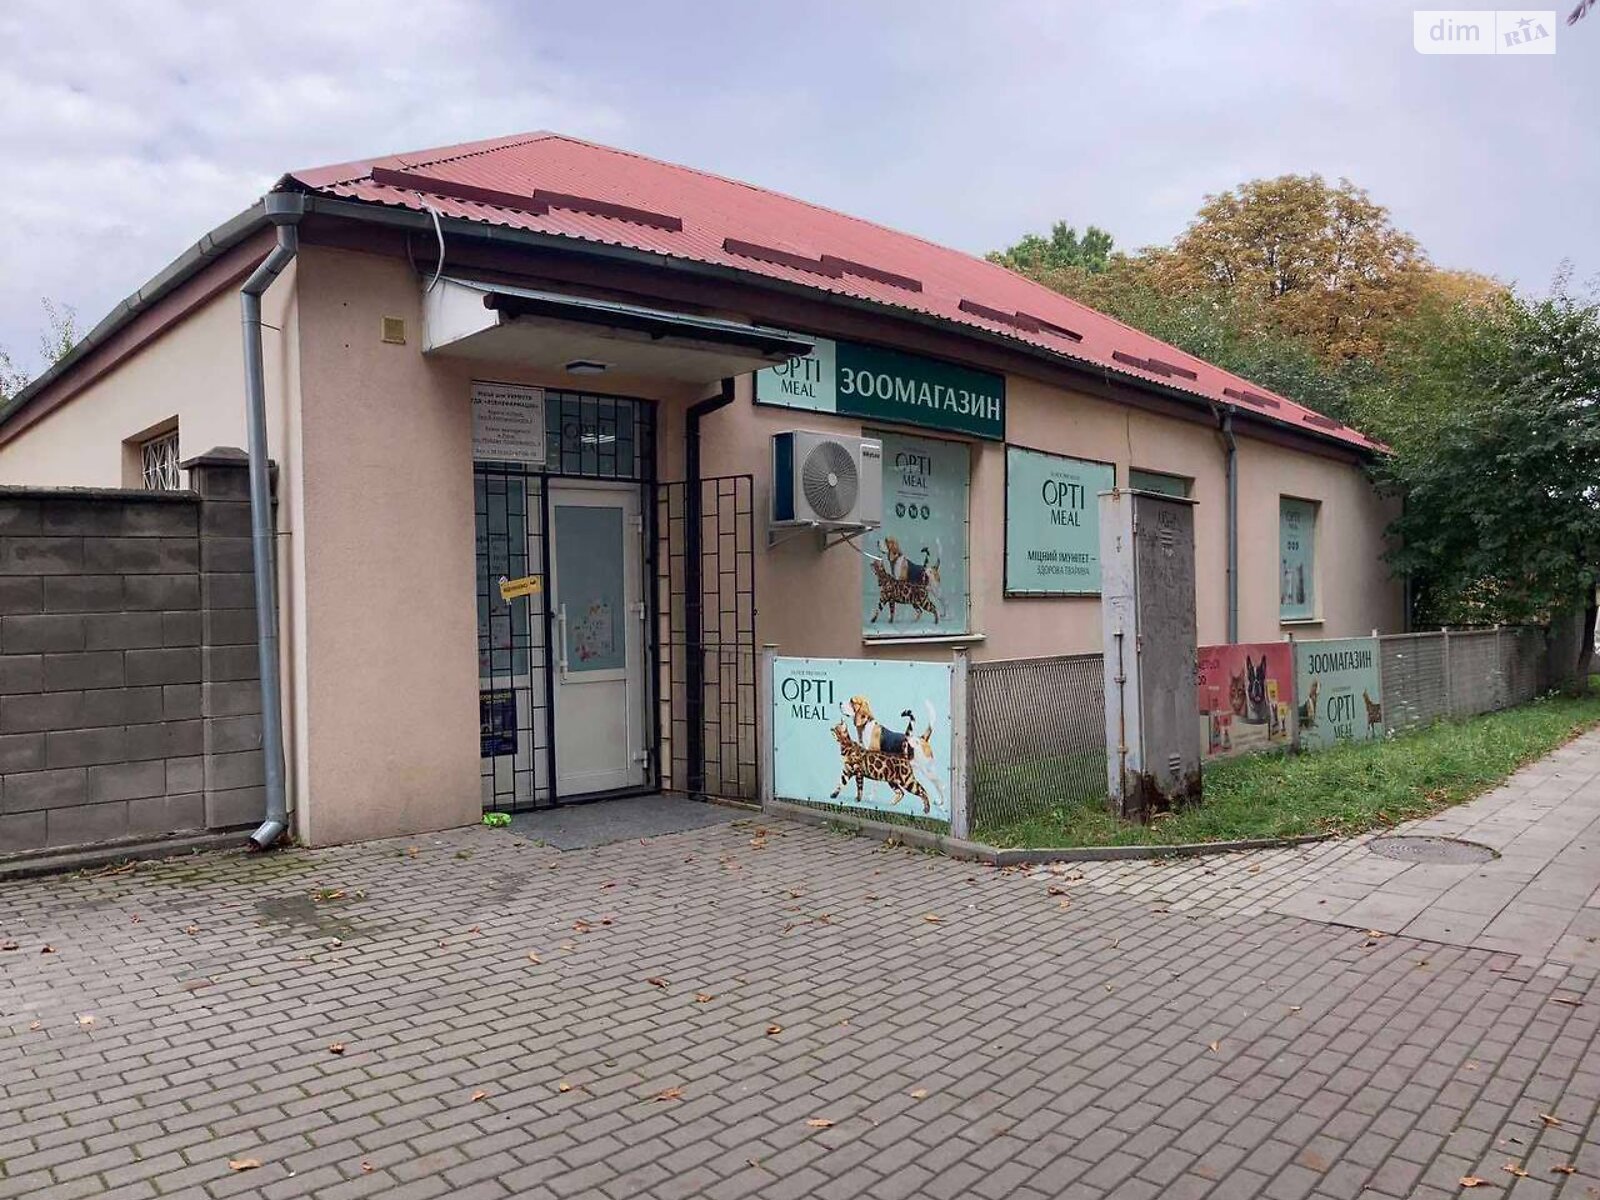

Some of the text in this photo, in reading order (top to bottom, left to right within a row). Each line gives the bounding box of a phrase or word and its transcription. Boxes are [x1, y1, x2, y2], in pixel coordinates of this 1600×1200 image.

[780, 379, 817, 398] MEAL
[840, 367, 1000, 421] ЗООМАГАЗИН
[895, 452, 931, 476] OPTI
[902, 474, 928, 489] MEAL
[1042, 479, 1084, 510] OPTI
[1050, 509, 1081, 527] MEAL
[1308, 650, 1372, 675] ЗООМАГАЗИН
[781, 677, 833, 705] OPTI
[791, 704, 831, 721] MEAL
[1327, 694, 1356, 724] OPTI
